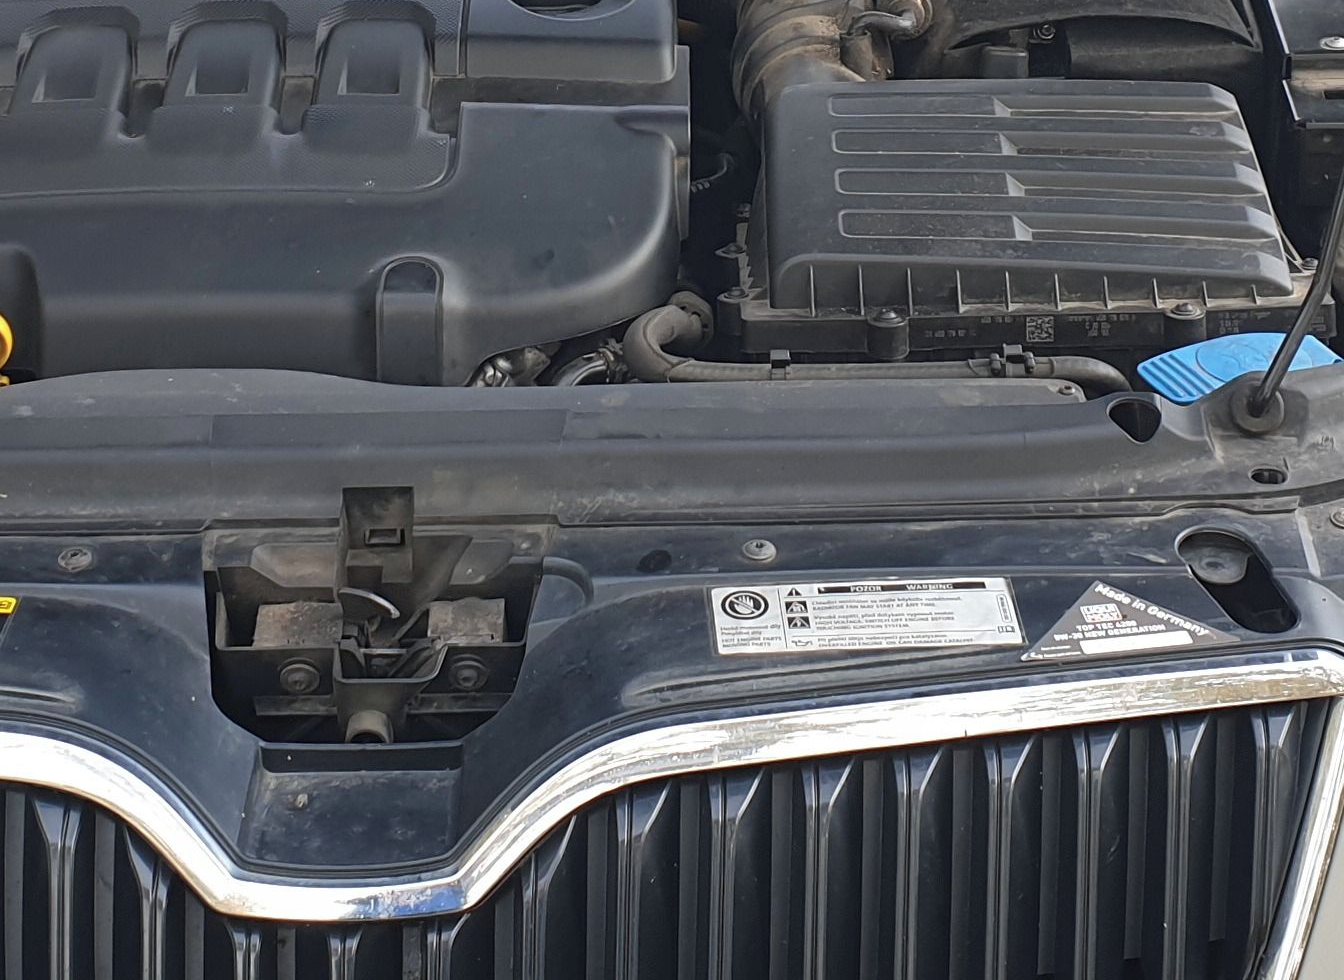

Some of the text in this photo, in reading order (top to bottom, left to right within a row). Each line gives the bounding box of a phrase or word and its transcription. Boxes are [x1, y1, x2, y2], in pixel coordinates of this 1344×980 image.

[849, 583, 954, 593] POZOR WARNING
[1094, 583, 1210, 637] Made in Germany
[1076, 624, 1095, 632] TOP
[1096, 622, 1115, 630] TEC
[1084, 630, 1106, 638] NEW
[1107, 623, 1166, 636] GENERATION
